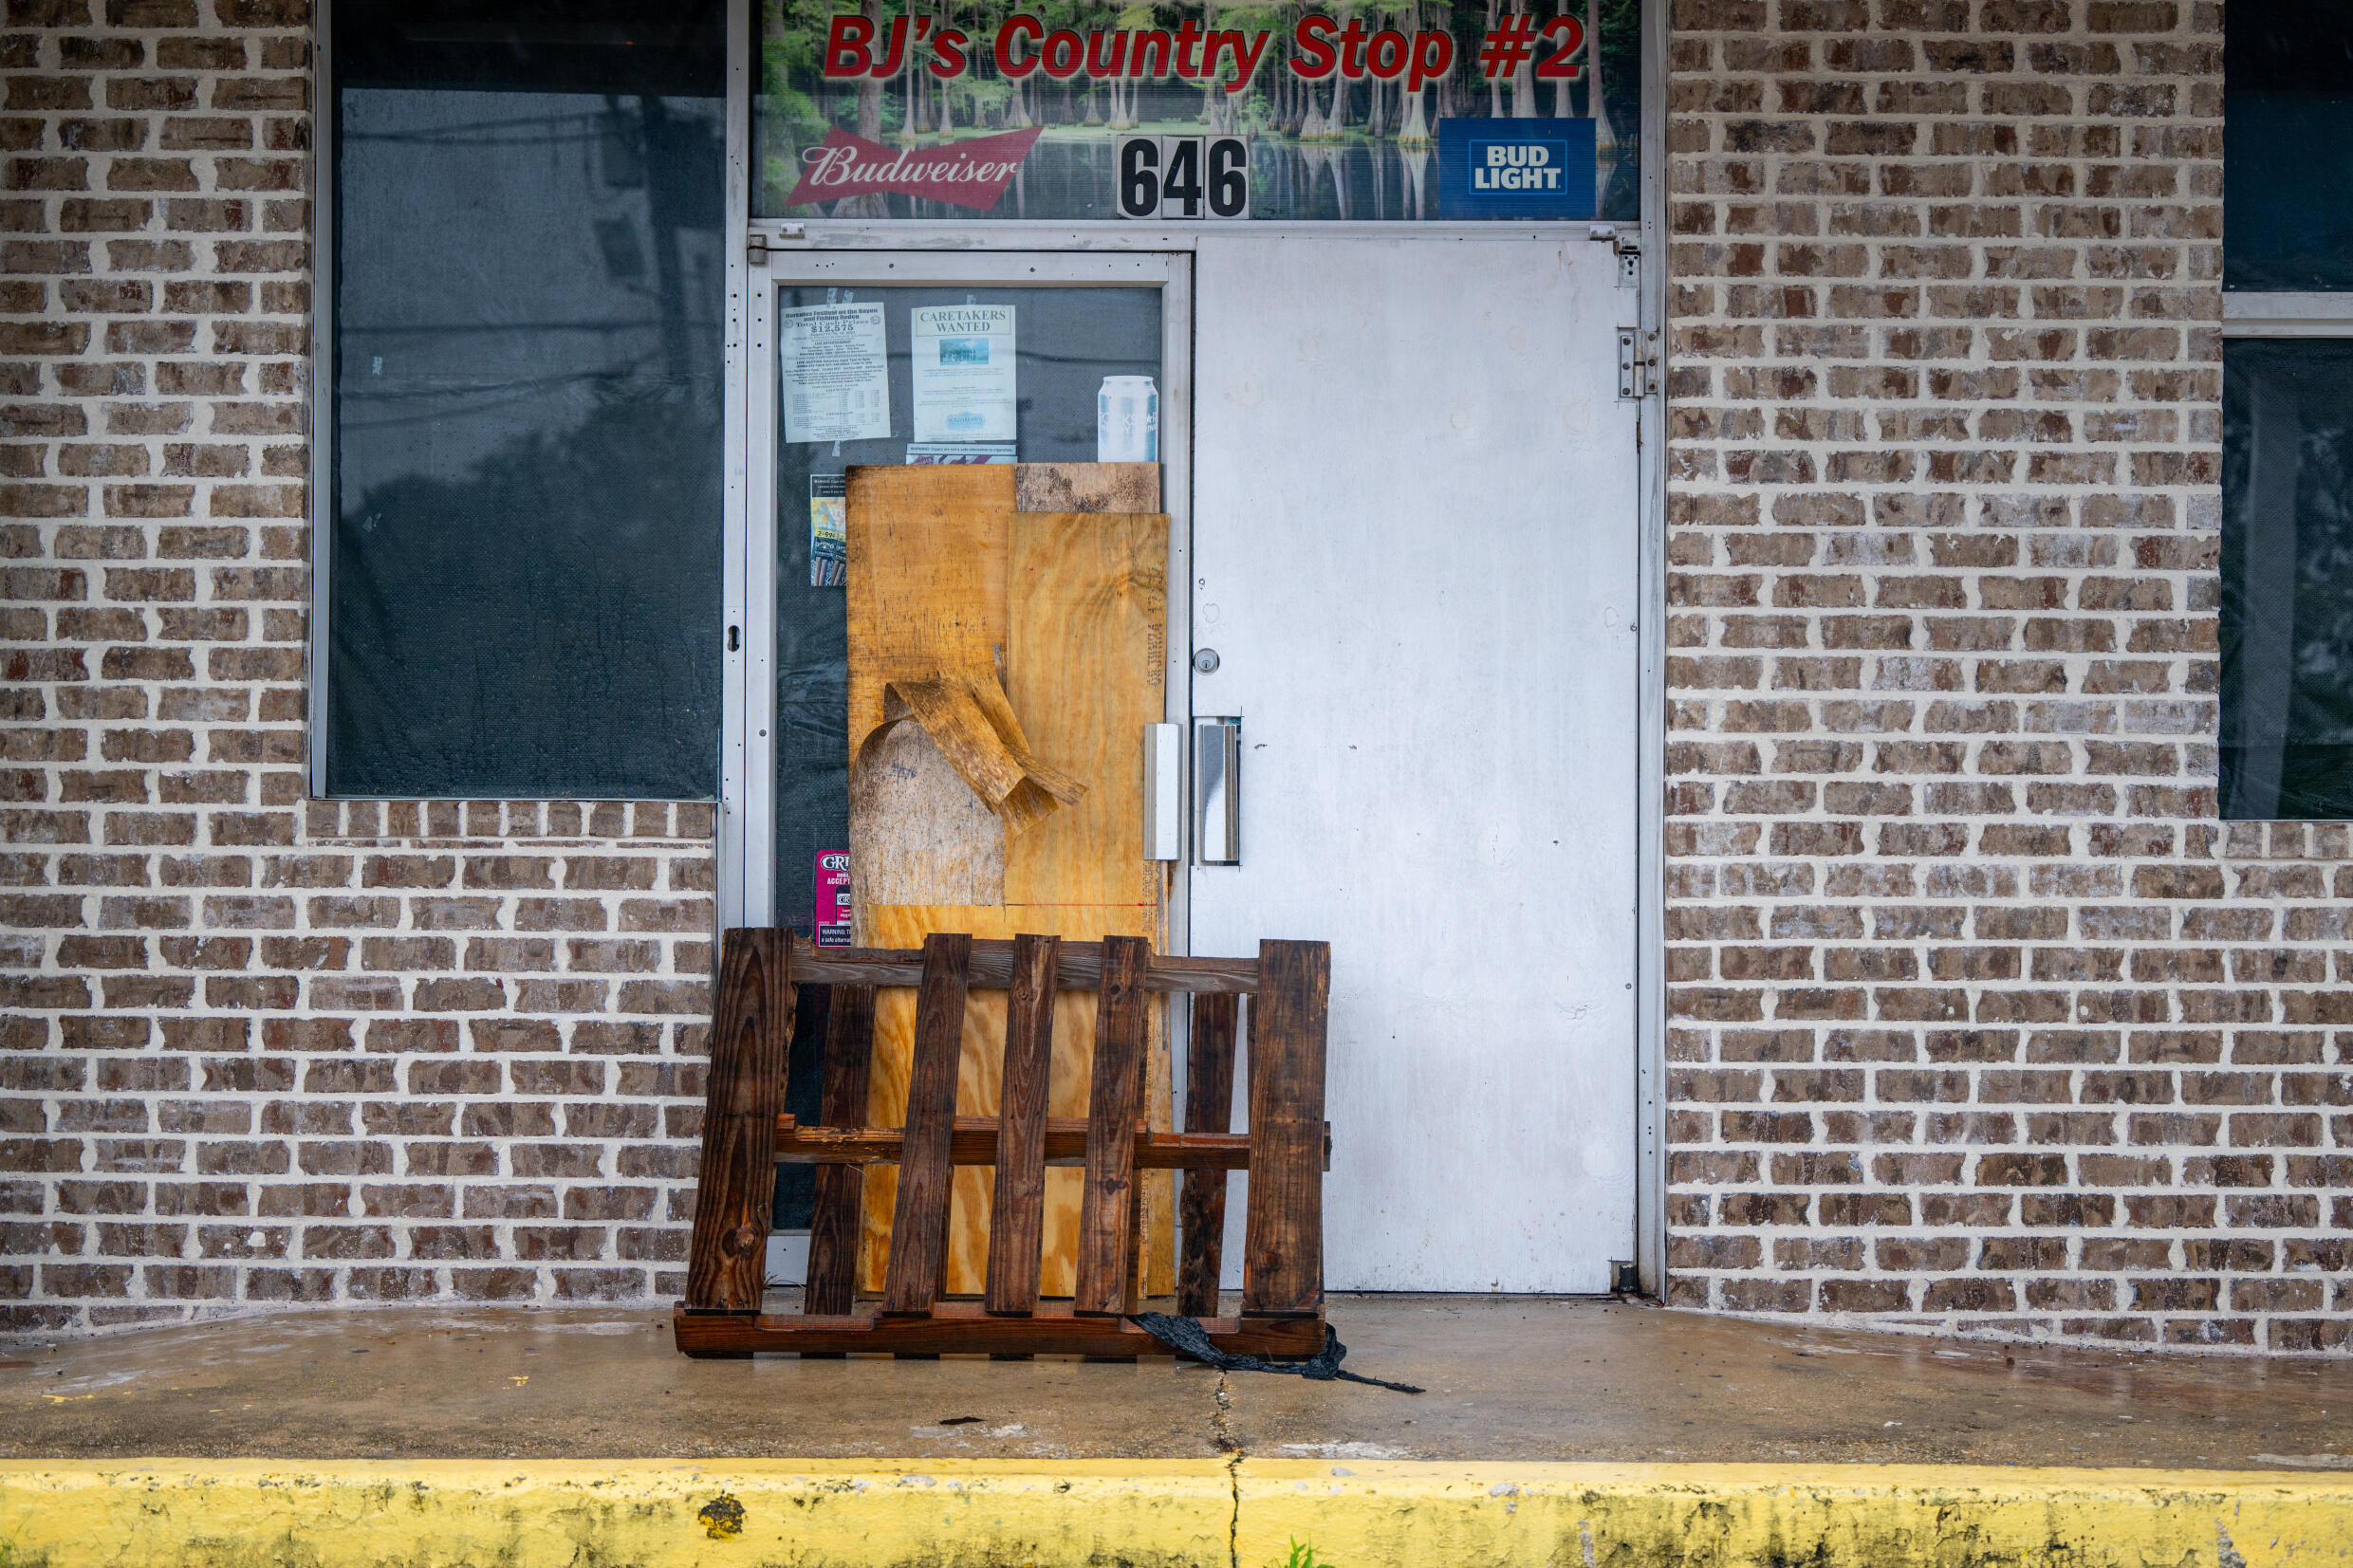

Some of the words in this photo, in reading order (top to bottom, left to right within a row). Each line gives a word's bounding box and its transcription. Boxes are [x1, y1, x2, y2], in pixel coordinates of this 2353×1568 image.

[824, 15, 970, 78] BJ's
[994, 14, 1269, 94] Country
[1289, 14, 1454, 93] Stop
[1479, 13, 1584, 79] #2
[802, 144, 1019, 187] Budweiser
[1487, 145, 1550, 167] BUD
[1121, 138, 1247, 218] 646
[1474, 167, 1563, 190] LIGHT
[919, 310, 1006, 323] CARETAKERS
[936, 322, 991, 332] WANTED
[810, 323, 854, 333] $12,575
